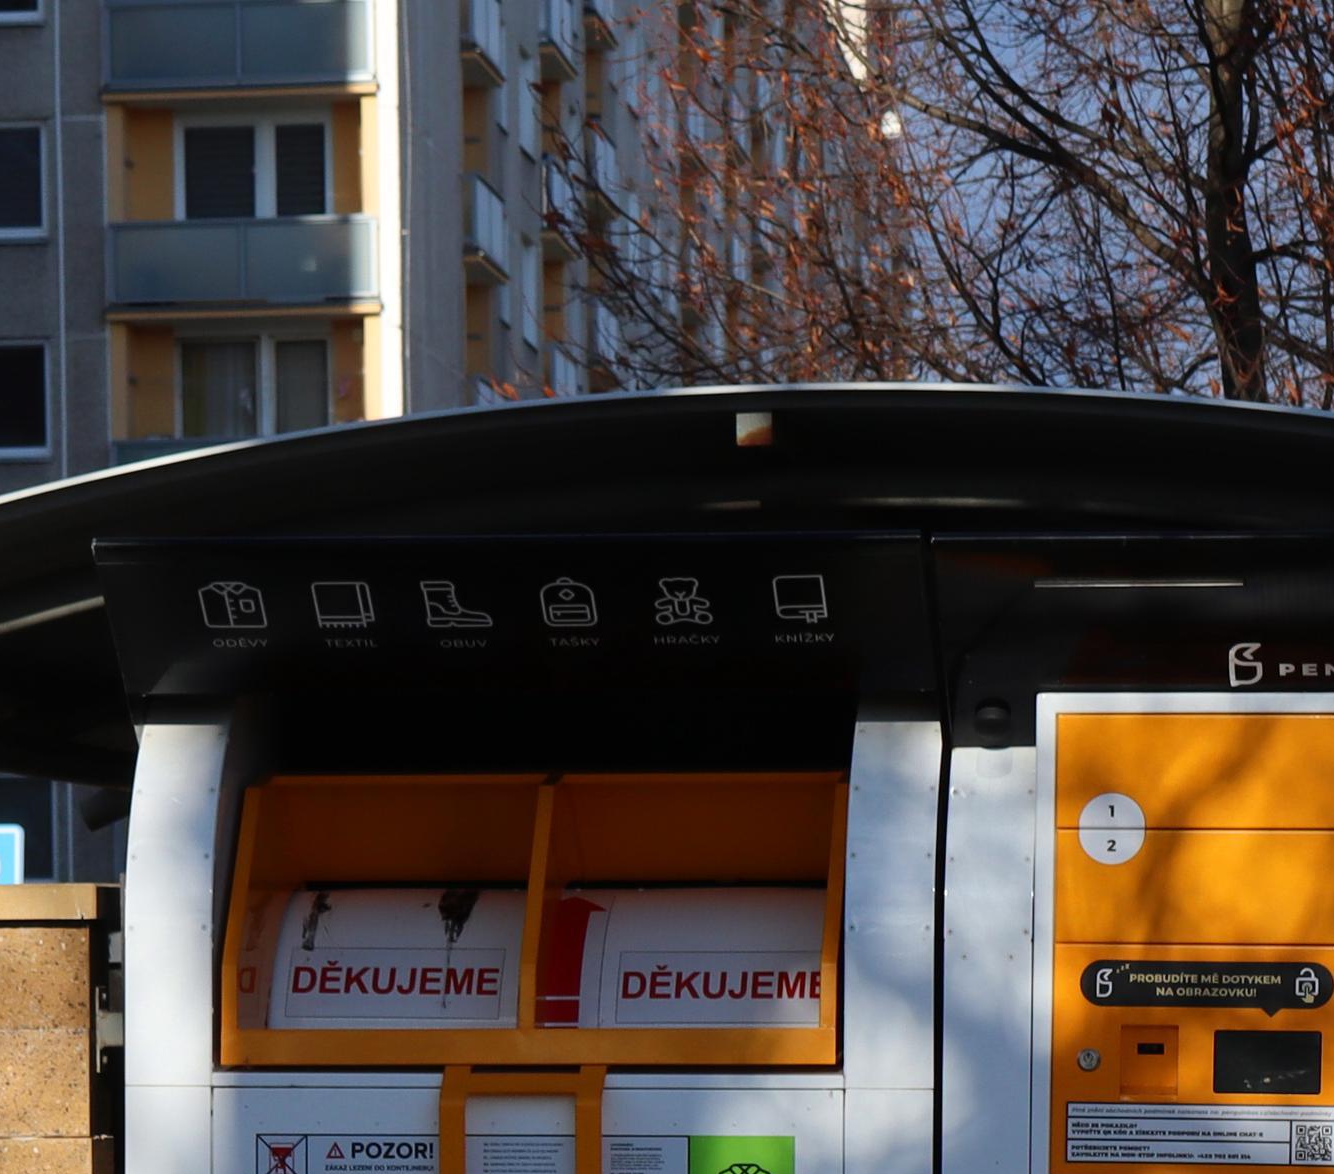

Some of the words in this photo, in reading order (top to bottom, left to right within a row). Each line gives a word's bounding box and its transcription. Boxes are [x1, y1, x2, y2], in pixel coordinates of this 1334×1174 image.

[213, 637, 268, 648] ODĚVY
[324, 638, 378, 648] TEXTIL
[439, 639, 488, 648] OBUV
[548, 635, 600, 648] TAŠKY
[653, 633, 721, 645] HRAČKY
[774, 630, 836, 643] KNÍŽKY
[1108, 805, 1115, 817] 1
[1106, 839, 1117, 852] 2
[291, 964, 500, 995] DĚKUJEME
[1129, 972, 1198, 984] PROBUDÍTE
[1201, 971, 1220, 984] MĚ
[1222, 973, 1282, 985] DOTYKEM
[1156, 986, 1174, 997] NA
[1176, 986, 1257, 998] OBRAZOVKU!
[351, 1142, 434, 1159] POZOR!
[325, 1163, 347, 1171] ZÁKAZ
[349, 1163, 372, 1171] LEZENÍ
